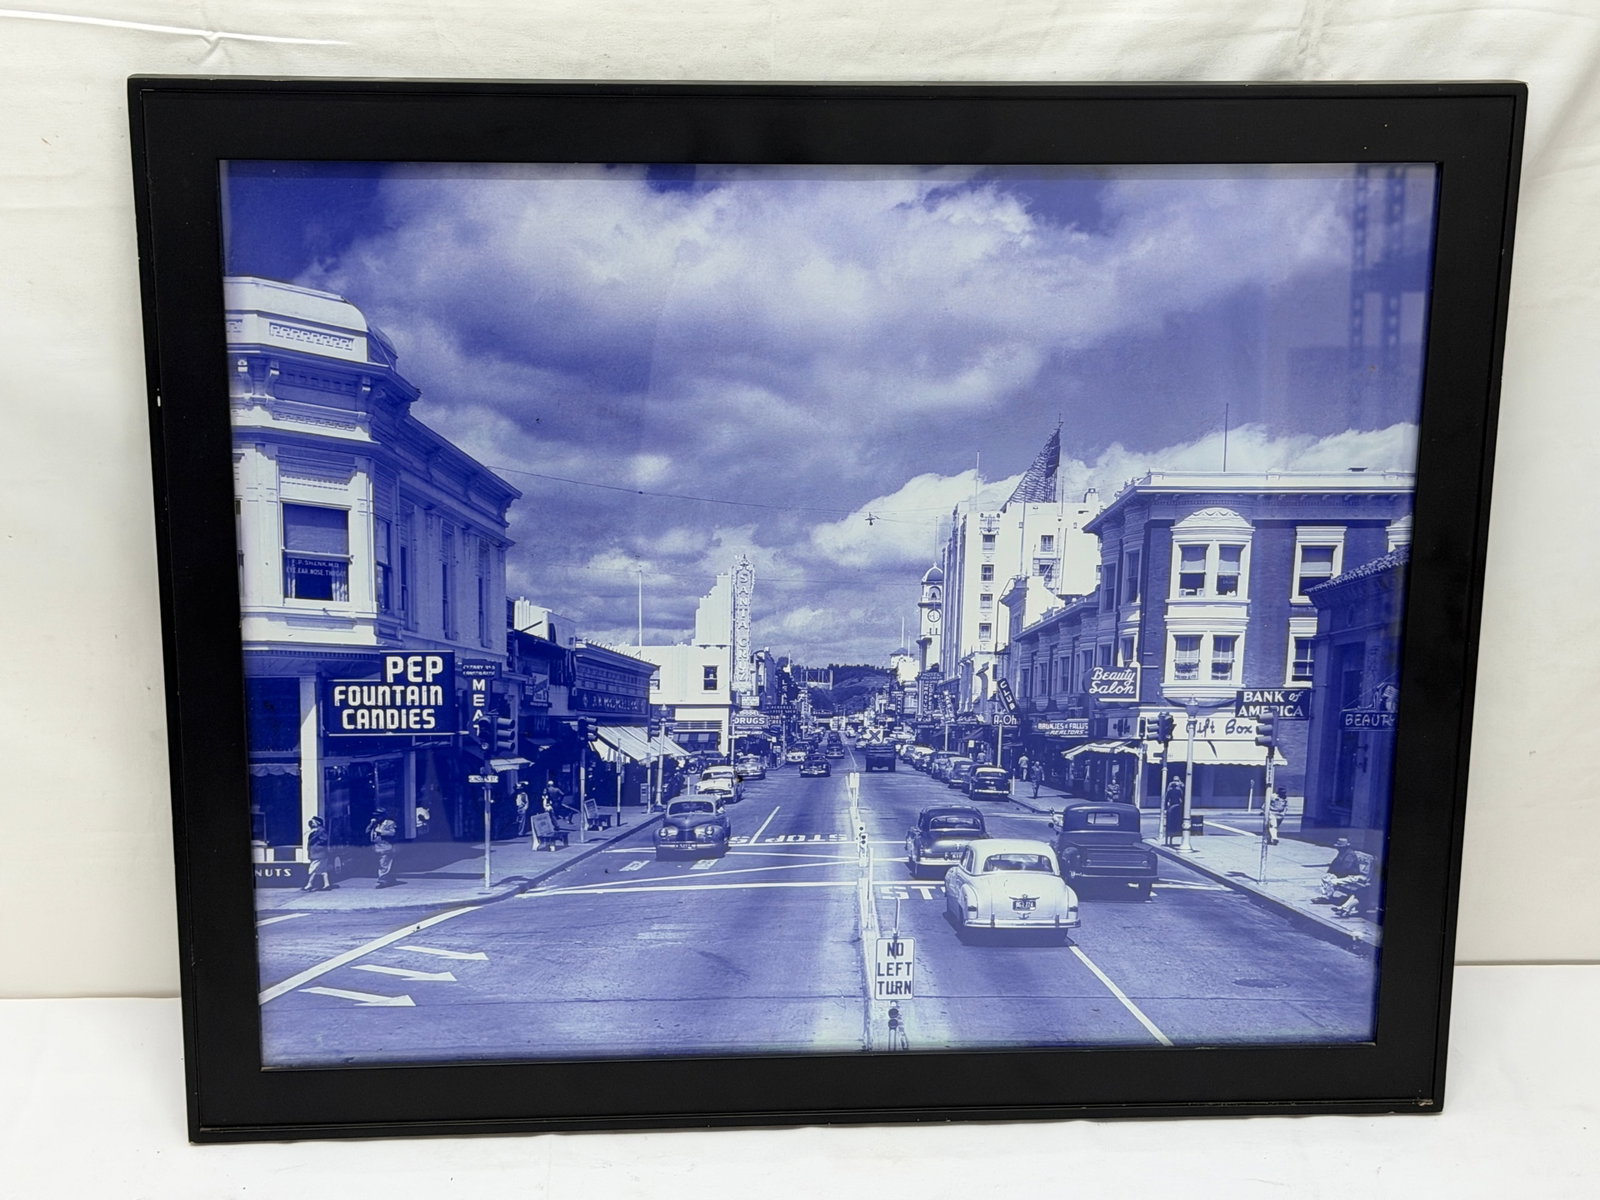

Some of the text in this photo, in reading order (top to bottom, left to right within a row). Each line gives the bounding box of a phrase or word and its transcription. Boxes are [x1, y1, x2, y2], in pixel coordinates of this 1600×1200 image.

[737, 573, 749, 630] SANTA
[386, 655, 443, 683] PEP
[1092, 667, 1136, 688] Beauty
[333, 685, 443, 707] FOUNTAIN
[1000, 680, 1016, 710] CLUB
[1089, 681, 1135, 695] Salon
[1243, 691, 1304, 703] BANK of
[342, 708, 436, 730] CANDIES
[1225, 718, 1253, 736] Box
[255, 868, 292, 877] NUTS
[880, 886, 946, 900] ST
[886, 942, 904, 957] NO
[877, 961, 912, 977] LEFT
[877, 980, 912, 995] TURN
